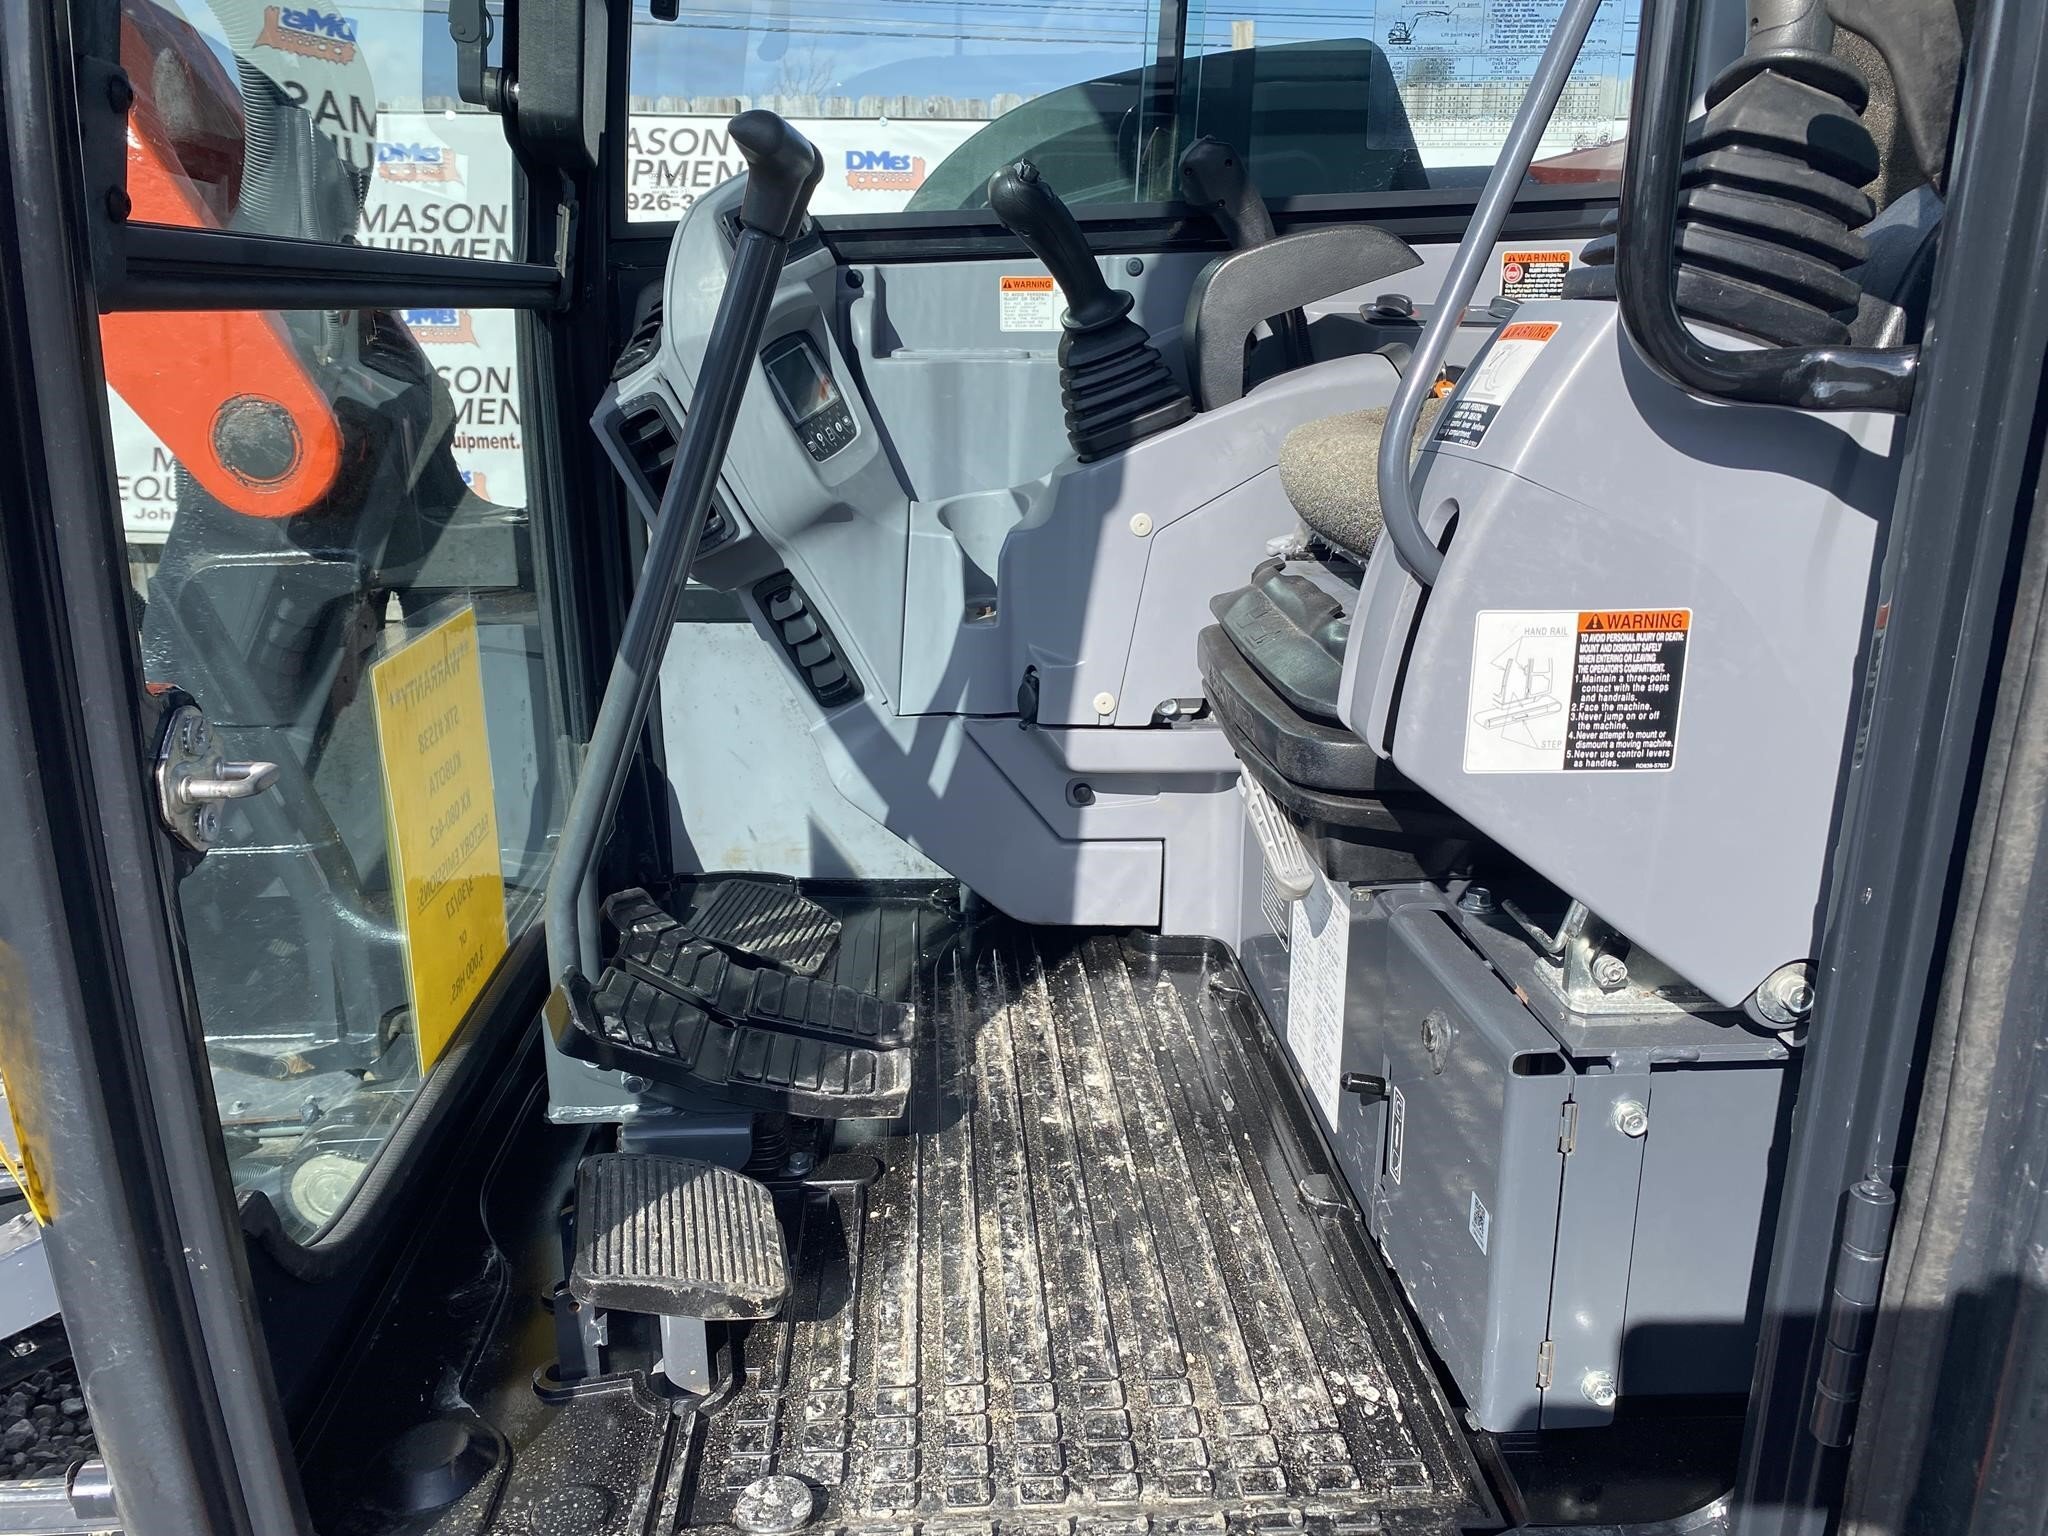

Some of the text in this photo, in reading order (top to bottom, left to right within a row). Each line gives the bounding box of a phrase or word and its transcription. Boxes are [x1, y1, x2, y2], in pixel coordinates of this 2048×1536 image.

[1518, 254, 1566, 262] WARNING
[1510, 326, 1552, 339] WARNING
[1608, 613, 1682, 629] WARNING
[1524, 627, 1568, 636] HAND RAIL
[1581, 634, 1589, 642] TO
[1589, 634, 1605, 642] AVOID
[1606, 633, 1635, 642] PERSONAL
[1636, 633, 1655, 642] INJURY
[1656, 633, 1664, 641] OR
[1580, 643, 1662, 653] MOUNT AND DISMOUNT SAFELY
[1579, 654, 1656, 663] WHEN ENTERING OR LEAVING
[1578, 665, 1589, 673] THE
[1589, 664, 1623, 673] OPERATOR'S
[1626, 673, 1670, 683] three-point
[1581, 684, 1669, 693] contact with the steps
[1598, 693, 1638, 701] handrails.
[1601, 703, 1614, 711] the
[1616, 703, 1652, 711] machine.
[1604, 712, 1623, 722] jump
[1649, 711, 1660, 720] off
[1578, 722, 1628, 730] the machine.
[1599, 731, 1625, 740] attempt
[1627, 731, 1633, 739] to
[1541, 740, 1562, 748] STEP
[1576, 740, 1608, 749] dismount
[1616, 740, 1641, 749] moving
[1643, 739, 1673, 747] machine.
[1600, 750, 1614, 758] use
[1617, 750, 1644, 758] control
[1646, 749, 1670, 757] levers
[1586, 759, 1619, 767] handles.
